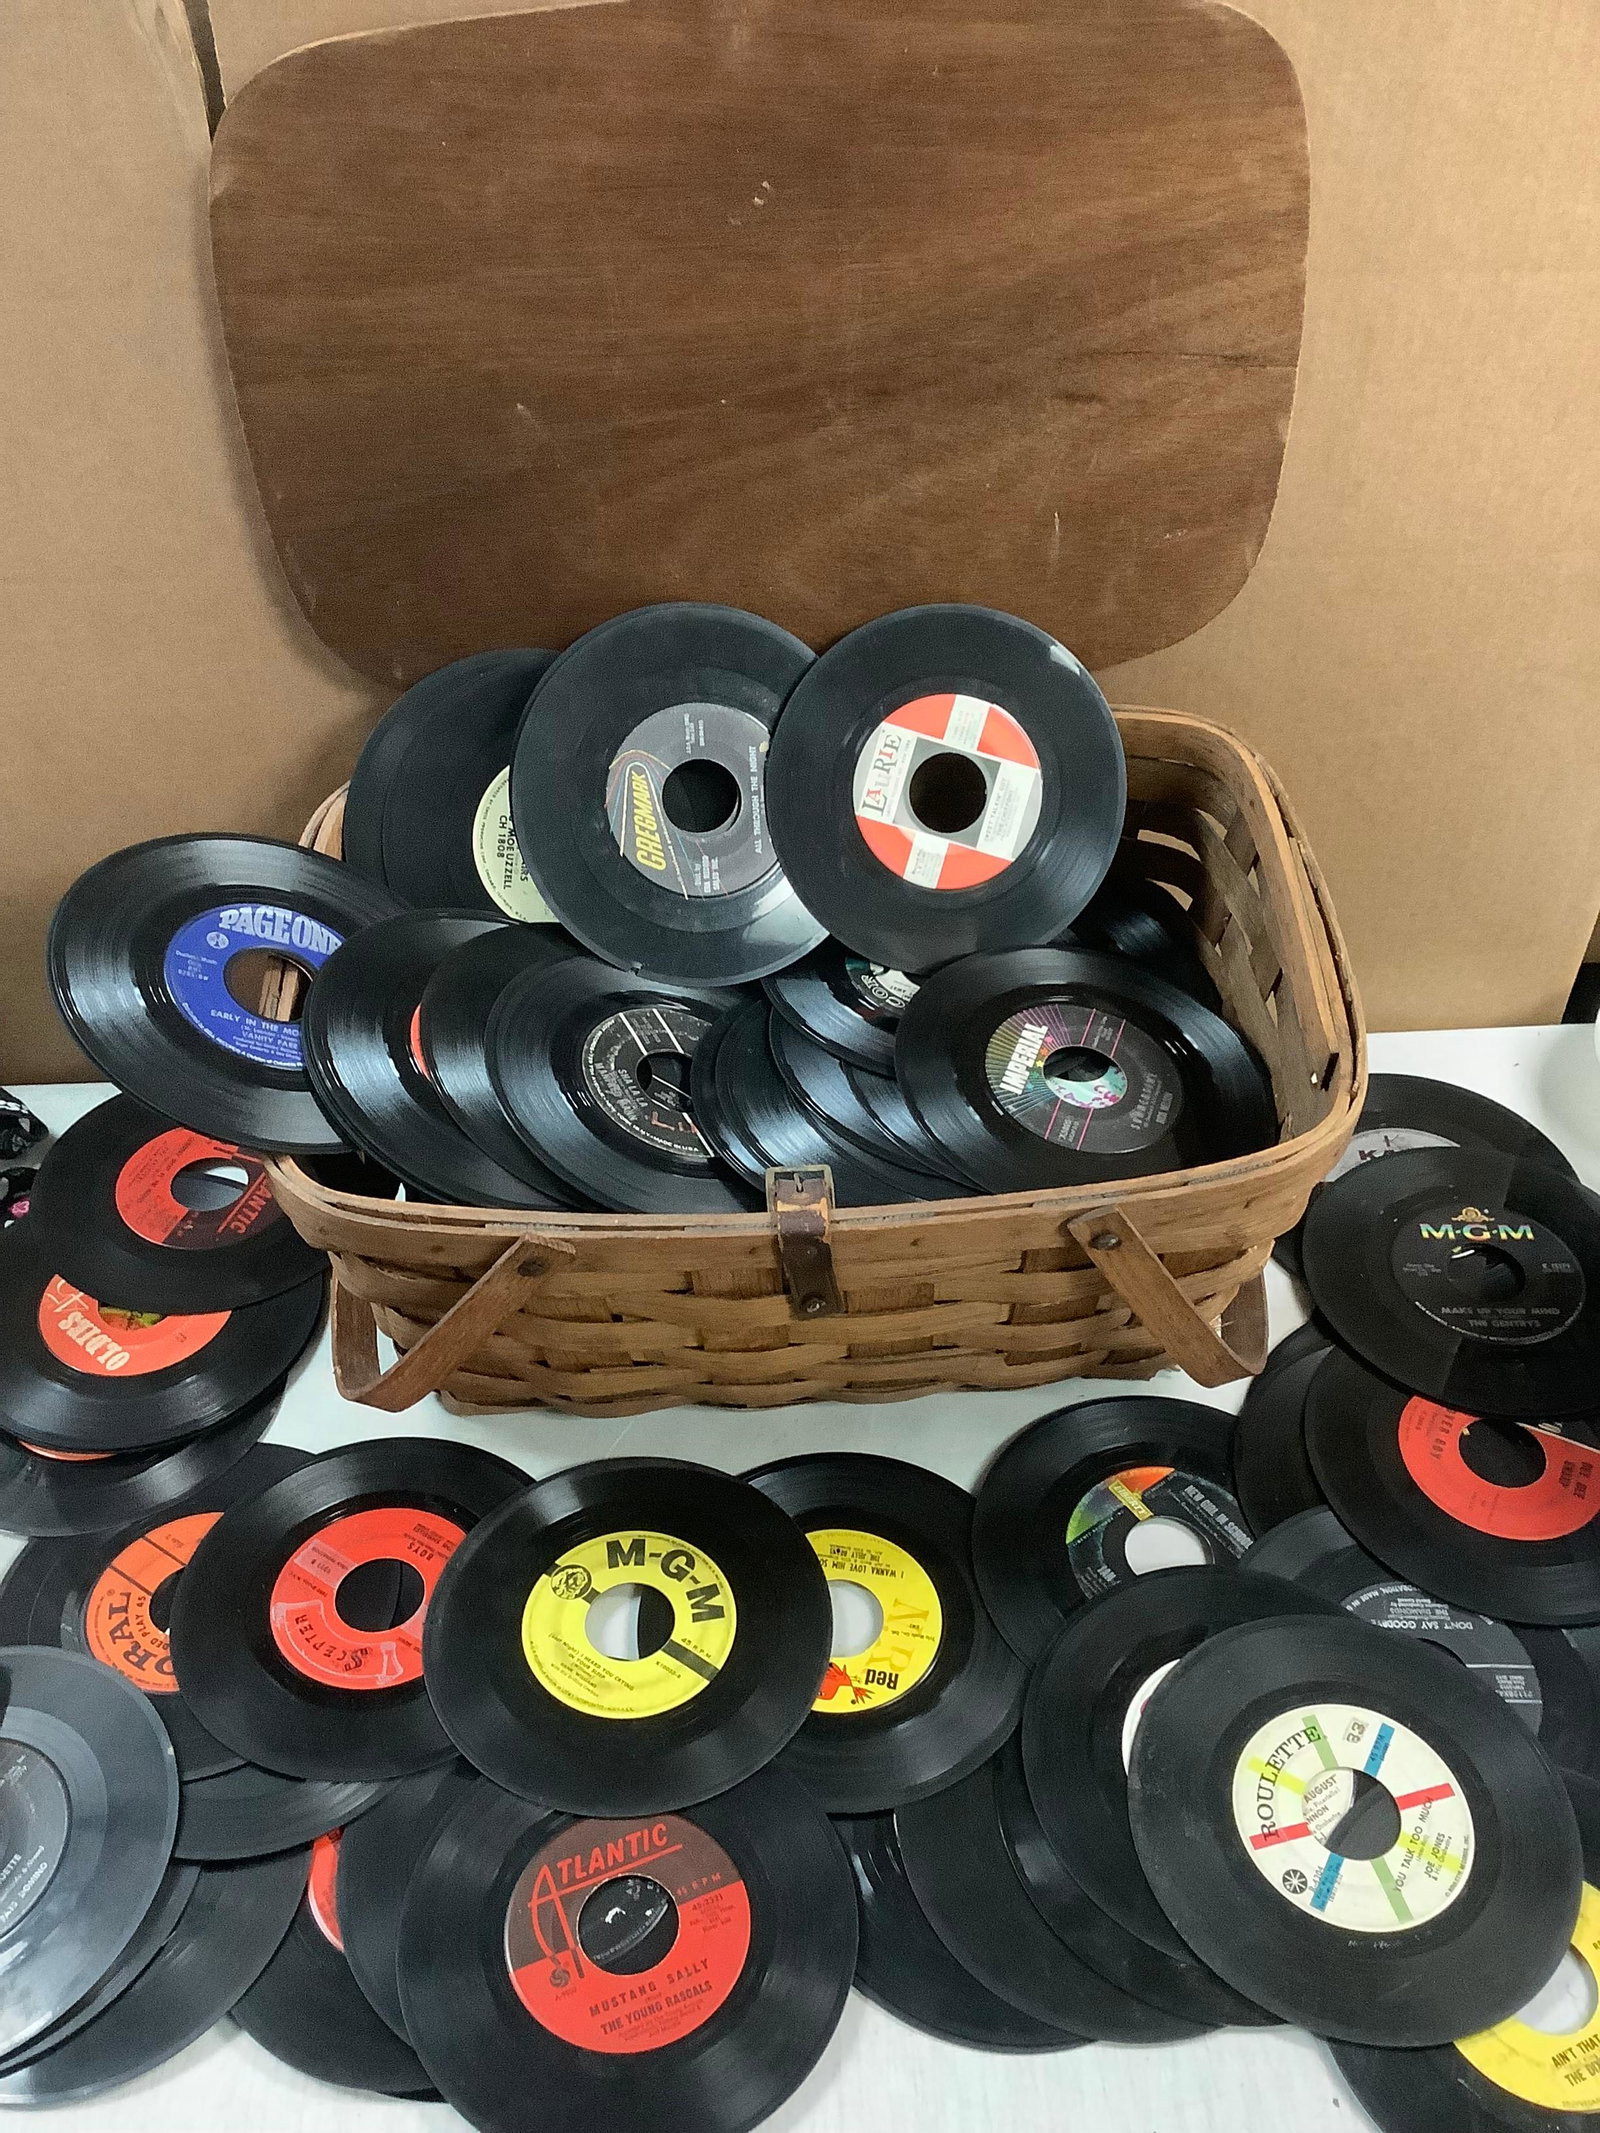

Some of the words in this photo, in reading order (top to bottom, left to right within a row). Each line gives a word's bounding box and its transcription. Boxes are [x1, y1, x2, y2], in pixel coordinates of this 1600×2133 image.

[500, 815, 507, 829] CH
[631, 771, 667, 871] GREGMARK
[497, 833, 506, 858] 1808
[219, 906, 292, 944] PAGE
[211, 1009, 241, 1022] EARLY
[245, 1018, 257, 1026] IN
[261, 1022, 279, 1032] THE
[242, 1031, 274, 1044] VANITY
[1000, 1022, 1048, 1095] IMPERIAL
[618, 1069, 633, 1085] SHA
[628, 1085, 640, 1096] LA
[638, 1098, 648, 1108] LA
[230, 1184, 273, 1234] ANTIC
[58, 1311, 130, 1371] OLDIES
[407, 1541, 434, 1561] BOYS
[851, 1552, 867, 1560] JELLY
[870, 1554, 880, 1562] THE
[832, 1562, 846, 1570] HIM
[850, 1565, 867, 1574] LOVE
[871, 1568, 897, 1578] WANNA
[606, 1538, 726, 1624] M-G-M
[136, 1595, 146, 1608] 45
[108, 1591, 175, 1676] ORAL
[135, 1614, 150, 1638] PLAY
[1421, 1620, 1438, 1629] SAY
[294, 1614, 369, 1672] SCEPTER
[681, 1637, 692, 1645] 45
[865, 1668, 899, 1690] Red
[1257, 1726, 1322, 1842] ROULETTE
[1303, 1803, 1330, 1826] NNON
[1414, 1794, 1437, 1823] MUCH
[1407, 1824, 1426, 1846] TOO
[1427, 1830, 1448, 1859] JONES
[0, 1853, 22, 1884] UETTE
[1399, 1847, 1418, 1871] TALK
[1421, 1859, 1438, 1878] JOE
[18, 1861, 48, 1899] DOMINO
[1389, 1870, 1409, 1893] YOU
[529, 1823, 670, 1978] ATLANTIC
[589, 1982, 658, 2017] MUSTANG
[666, 1959, 710, 1985] SALLY
[601, 2017, 623, 2036] THE
[625, 2001, 663, 2027] YOUNG
[665, 1980, 714, 2009] RASCALS
[1551, 2048, 1577, 2069] AIN'T
[1576, 2034, 1600, 2055] THAT
[1564, 2068, 1587, 2087] THE
